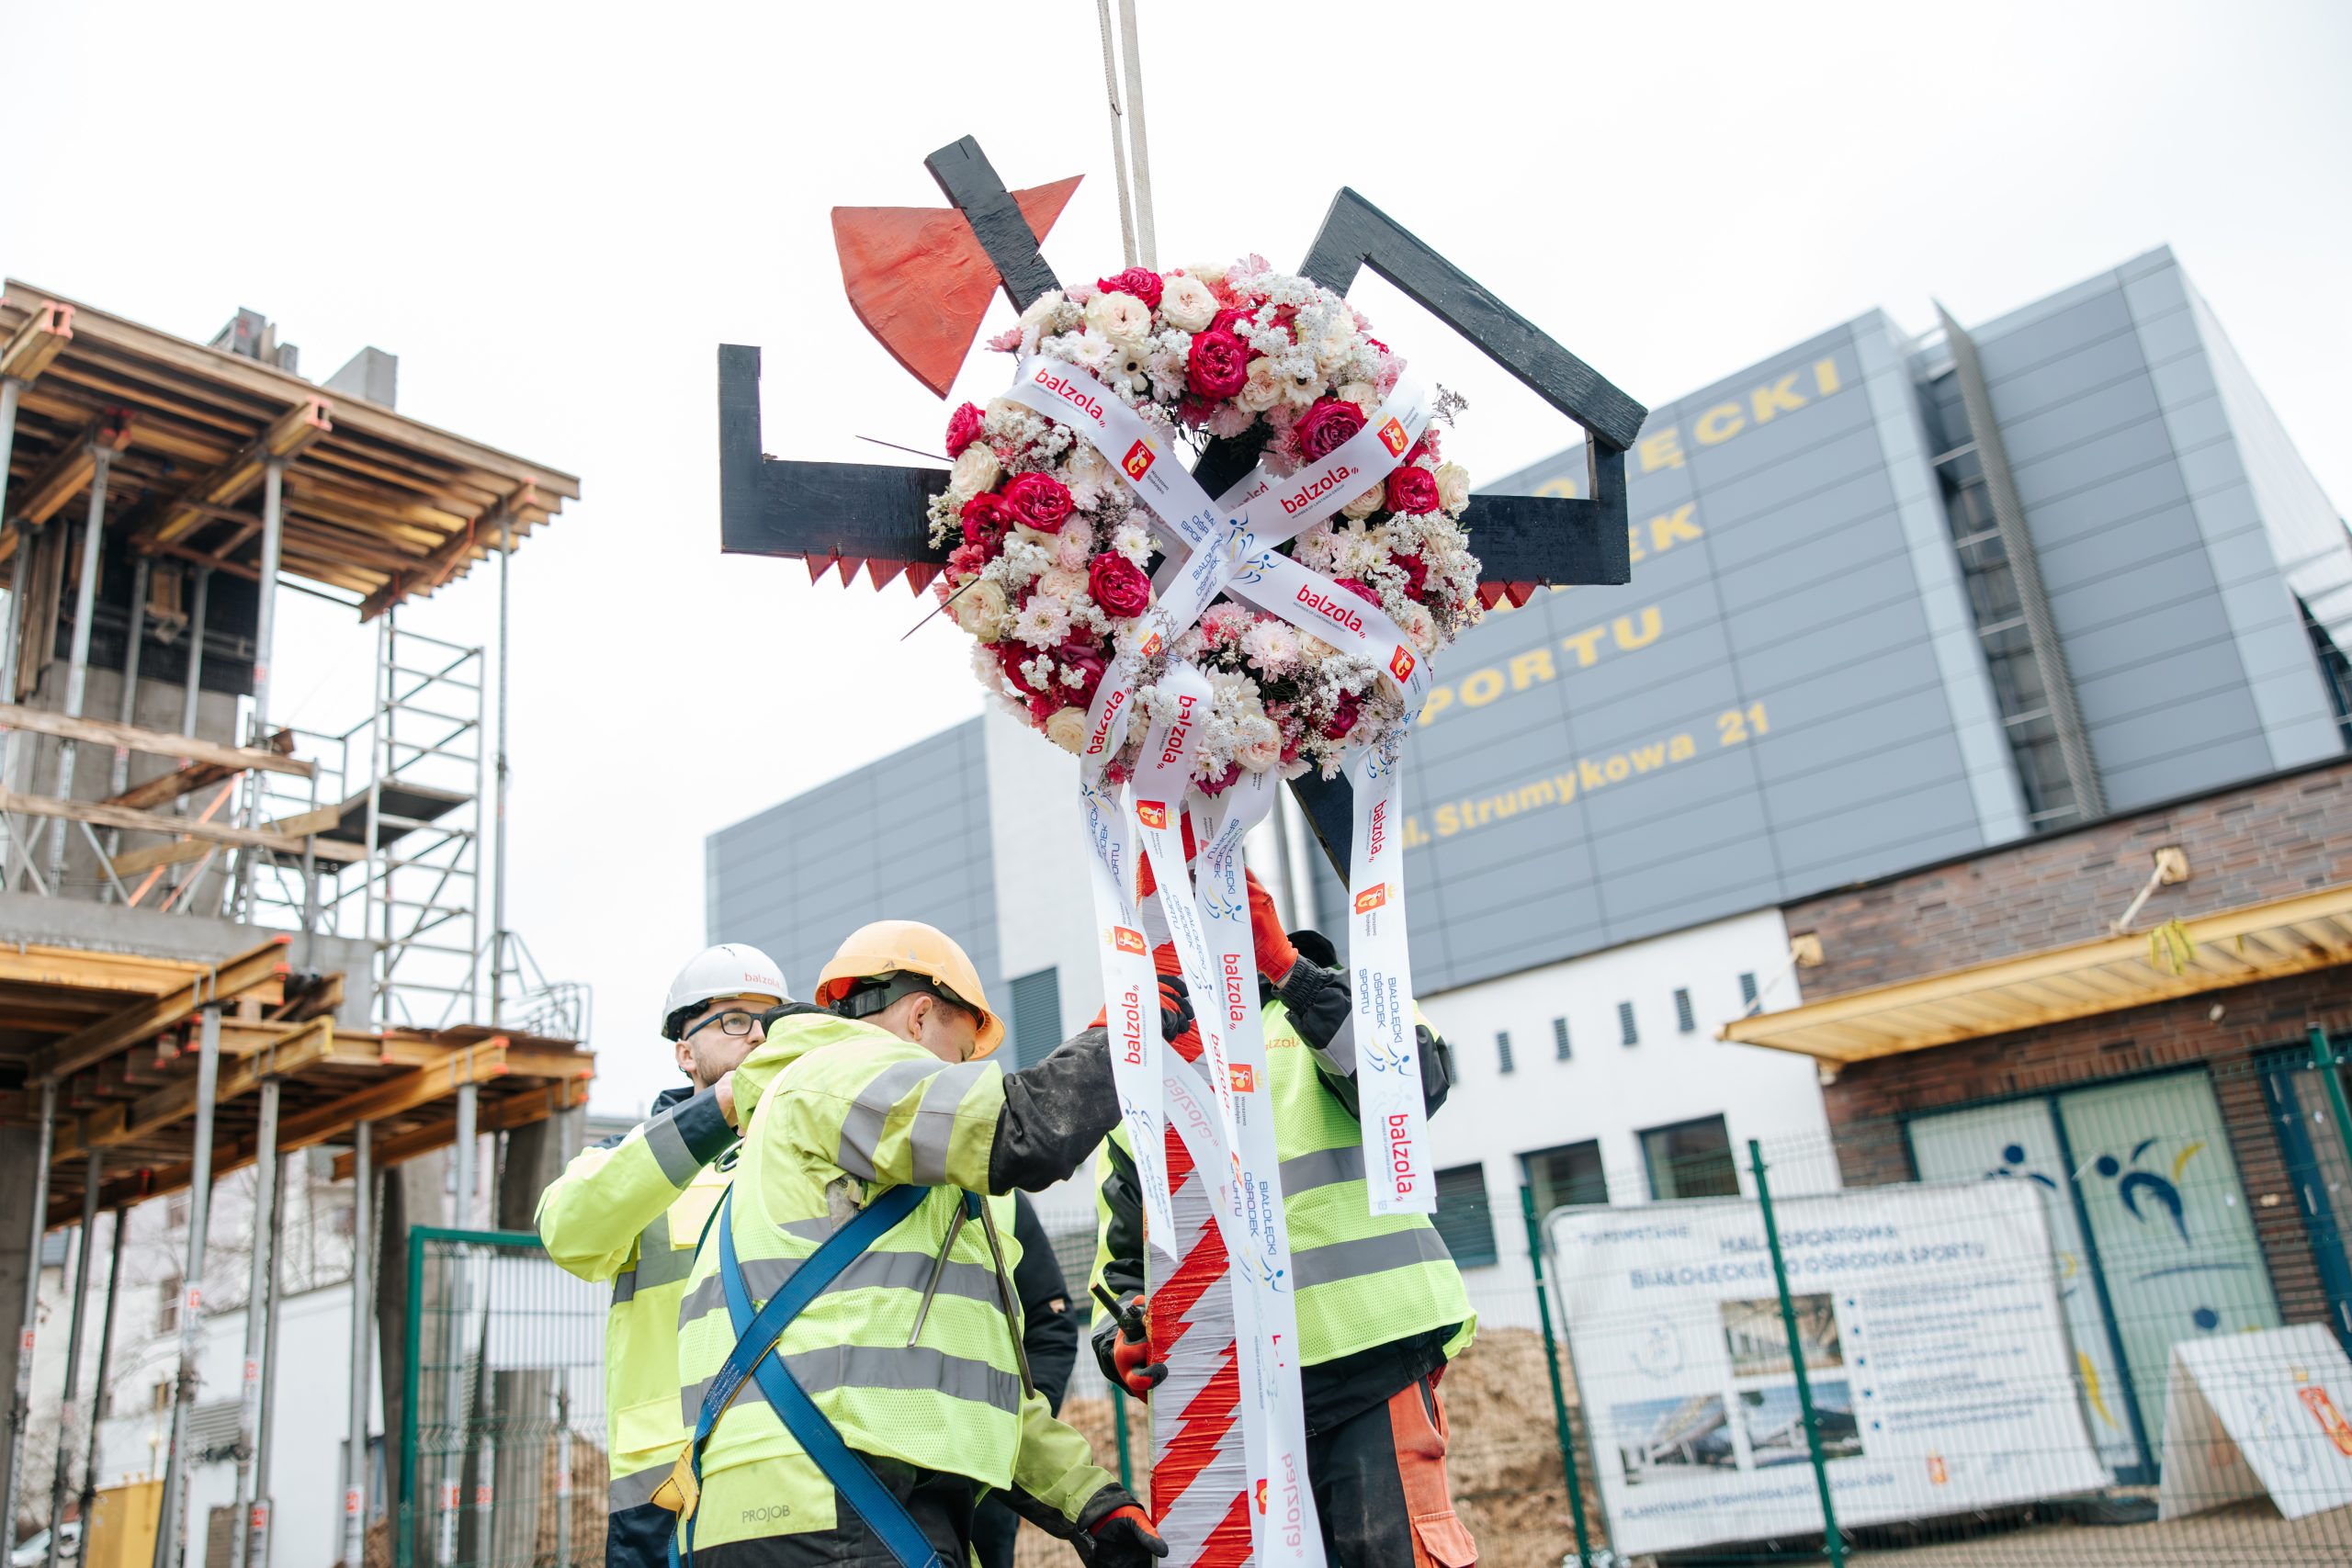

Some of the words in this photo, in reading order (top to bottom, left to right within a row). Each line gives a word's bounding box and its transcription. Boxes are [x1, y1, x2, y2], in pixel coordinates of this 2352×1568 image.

[1035, 367, 1103, 421] balzola
[1280, 466, 1351, 514] balzola
[1296, 584, 1363, 632] balzola
[1417, 604, 1664, 728] PORTU
[1086, 690, 1125, 755] balzola
[1434, 732, 1697, 838] Strumykowa
[1717, 702, 1770, 748] 21
[1370, 799, 1387, 855] balzola
[1223, 953, 1244, 1022] balzola
[1359, 968, 1370, 1014] SPORTU
[1373, 972, 1385, 1029] OŚRODEK
[1388, 976, 1403, 1043] BIAŁOŁĘCKI
[1121, 990, 1141, 1066] balzola
[1388, 1113, 1416, 1193] balzola
[1244, 1171, 1259, 1237] OŚRODEK
[1259, 1181, 1277, 1256] BIAŁOŁĘCKI
[741, 1505, 790, 1523] PROJOB
